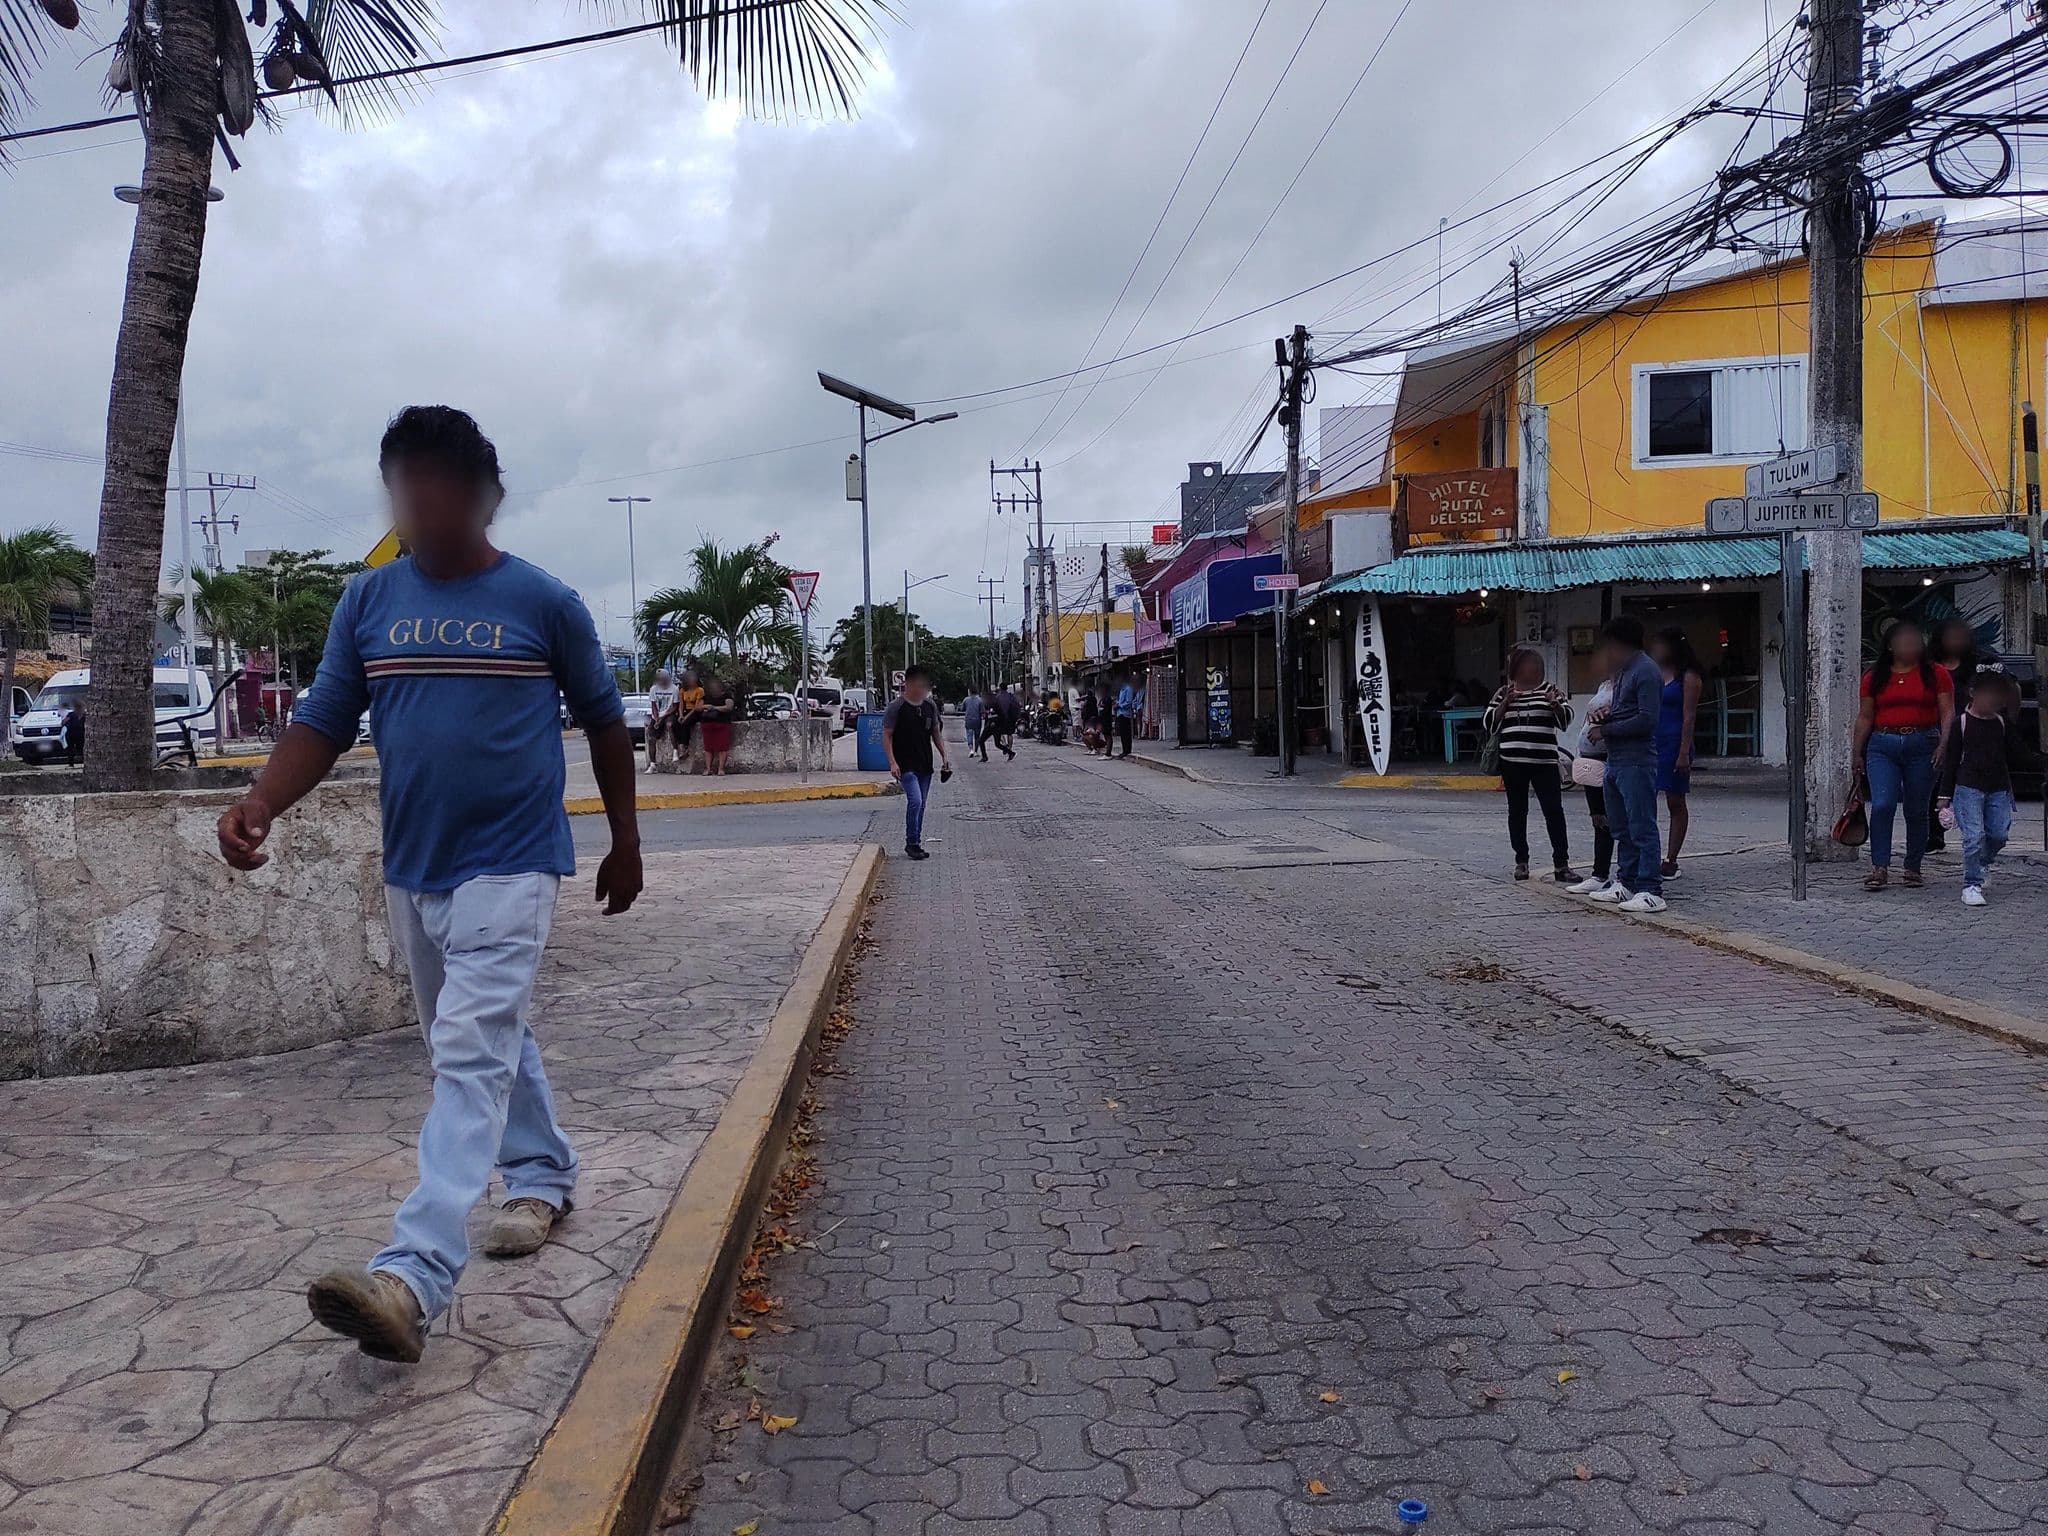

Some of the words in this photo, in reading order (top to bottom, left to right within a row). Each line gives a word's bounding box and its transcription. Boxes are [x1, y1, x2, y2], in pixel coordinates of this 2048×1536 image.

[1769, 461, 1809, 485] TULUM
[1440, 499, 1484, 512] RUTA
[1754, 503, 1807, 522] JUPITER
[1813, 503, 1838, 519] NTE.
[1430, 513, 1457, 526] DEL
[1460, 511, 1486, 524] SOL
[1268, 577, 1298, 587] HOTEL
[1182, 580, 1207, 635] telcel
[388, 618, 504, 649] GUCCI
[1362, 603, 1373, 648] SHOP
[1371, 676, 1383, 699] FISH
[1369, 713, 1382, 755] TACO
